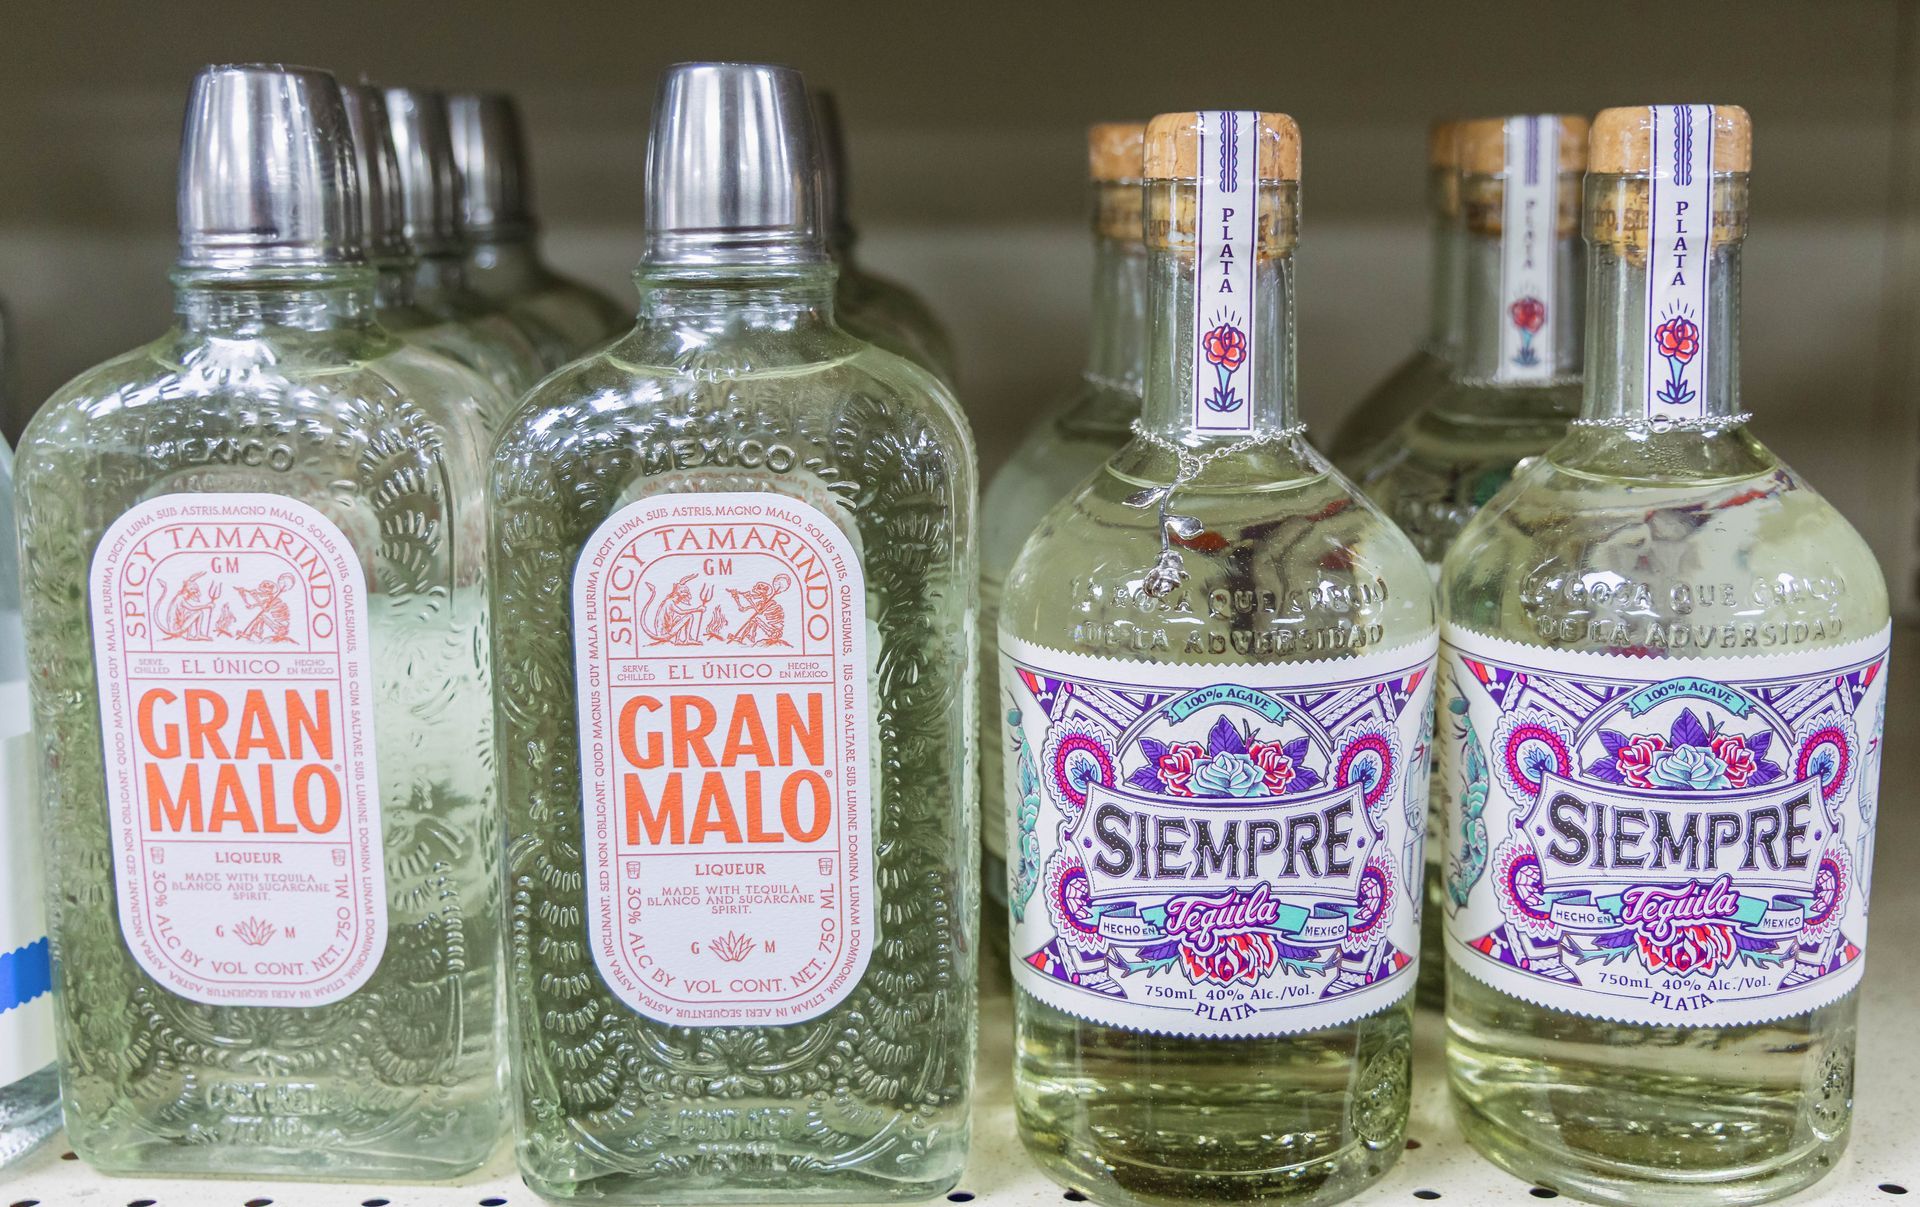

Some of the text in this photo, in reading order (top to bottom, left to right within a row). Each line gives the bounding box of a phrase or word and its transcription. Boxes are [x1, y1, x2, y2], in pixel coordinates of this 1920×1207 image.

[1218, 207, 1235, 293] PLATA
[1671, 201, 1688, 287] PLATA
[156, 507, 178, 519] SUB
[646, 508, 669, 521] SUB
[126, 515, 155, 537] LUNA
[614, 516, 645, 540] LUNA
[107, 535, 128, 563] DICIT
[307, 524, 337, 554] SOLUS
[805, 523, 835, 554] SOLUS
[592, 537, 615, 568] DICIT
[102, 566, 115, 615] PLURIMA
[123, 526, 334, 639] SPICY TAMARINDO
[608, 526, 830, 645] SPICY TAMARINDO
[586, 571, 600, 621] PLURIMA
[104, 618, 117, 652] MALA
[587, 624, 598, 660] MALA
[134, 658, 170, 675] SERVE CHILLED
[182, 657, 280, 675] EL ÚNICO
[287, 667, 299, 676] EN
[294, 659, 325, 667] HECHO
[348, 661, 358, 679] IUS
[617, 664, 656, 681] SERVE CHILLED
[668, 661, 772, 680] EL ÚNICO
[780, 670, 791, 679] EN
[788, 662, 819, 670] HECHO
[843, 664, 853, 681] IUS
[349, 681, 360, 706] CUM
[844, 684, 854, 710] CUM
[1183, 688, 1272, 711] 100% AGAVE
[1644, 681, 1734, 705] 100% AGAVE
[138, 688, 334, 760] GRAN
[591, 690, 603, 740] MAGNUS
[351, 710, 363, 757] SALTARE
[618, 692, 825, 769] GRAN
[845, 714, 856, 763] SALTARE
[115, 732, 127, 765] QUOD
[593, 742, 605, 777] QUOD
[846, 766, 856, 787] SUB
[145, 763, 342, 834] MALO
[355, 784, 368, 824] LUMINE
[623, 769, 832, 845] MALO
[847, 790, 858, 832] LUMINE
[124, 828, 134, 852] NON
[1093, 794, 1356, 881] SIEMPRE
[1546, 790, 1812, 872] SIEMPRE
[215, 852, 283, 865] LIQUEUR
[358, 827, 372, 873] DOMINA
[598, 842, 609, 867] NON
[848, 835, 860, 882] DOMINA
[185, 873, 316, 884] MADE WITH TEQUILA
[600, 870, 610, 892] SED
[695, 863, 767, 876] LIQUEUR
[172, 882, 331, 893] BLANCO AND SUGARCANE
[334, 874, 350, 899] ML
[362, 877, 375, 915] LUNAM
[661, 884, 800, 896] MADE WITH TEQUILA
[647, 894, 815, 906] BLANCO AND SUGARCANE
[711, 904, 753, 914] SPIRIT.
[849, 885, 860, 925] LUNAM
[1622, 873, 1739, 940] Tequila
[335, 907, 352, 941] 750
[1165, 882, 1280, 949] Tequila
[1556, 910, 1612, 925] HECHO EN
[1763, 916, 1801, 929] MEXICO
[155, 914, 181, 949] ALC
[626, 883, 836, 993] 30% ALC BY VOL CONT. NET. 750 ML
[1103, 921, 1156, 936] HECHO EN
[1304, 923, 1346, 937] MEXICO
[180, 949, 204, 968] BY
[690, 940, 776, 955] G M
[211, 961, 249, 974] VOL
[254, 962, 309, 976] CONT.
[610, 959, 636, 992] ASTRA
[169, 970, 204, 993] ASTRA
[1144, 985, 1197, 1000] 750mL
[1206, 988, 1245, 1001] 40%
[1598, 972, 1653, 989] 750mL
[1661, 979, 1702, 992] 40%
[638, 991, 673, 1015] ASTRA
[776, 1007, 788, 1017] IN
[791, 993, 826, 1015] ETIAM
[1194, 1001, 1259, 1022] PLATA
[1649, 990, 1715, 1011] PLATA
[676, 1008, 742, 1019] SEQUENTUR
[745, 1008, 772, 1018] AERI
